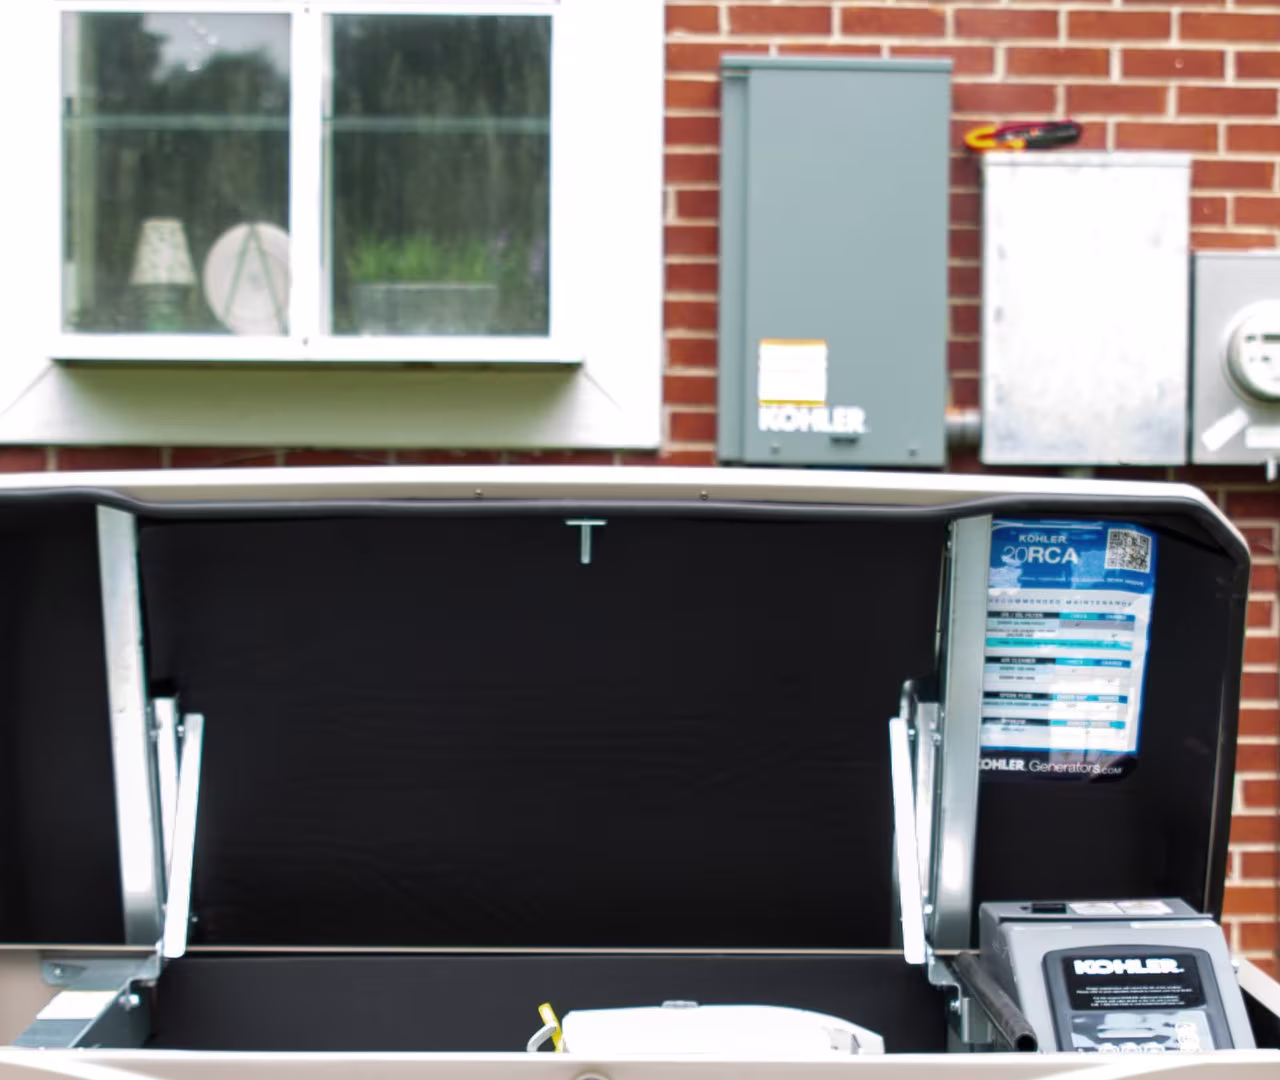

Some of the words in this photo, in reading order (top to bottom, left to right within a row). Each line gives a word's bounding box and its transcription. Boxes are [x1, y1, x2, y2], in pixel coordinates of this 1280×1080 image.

[758, 405, 866, 432] KOHLER
[1018, 534, 1067, 544] KOHLER
[1001, 545, 1079, 565] 20RCA
[978, 757, 1025, 772] OHLER
[1073, 958, 1182, 975] KOHLER
